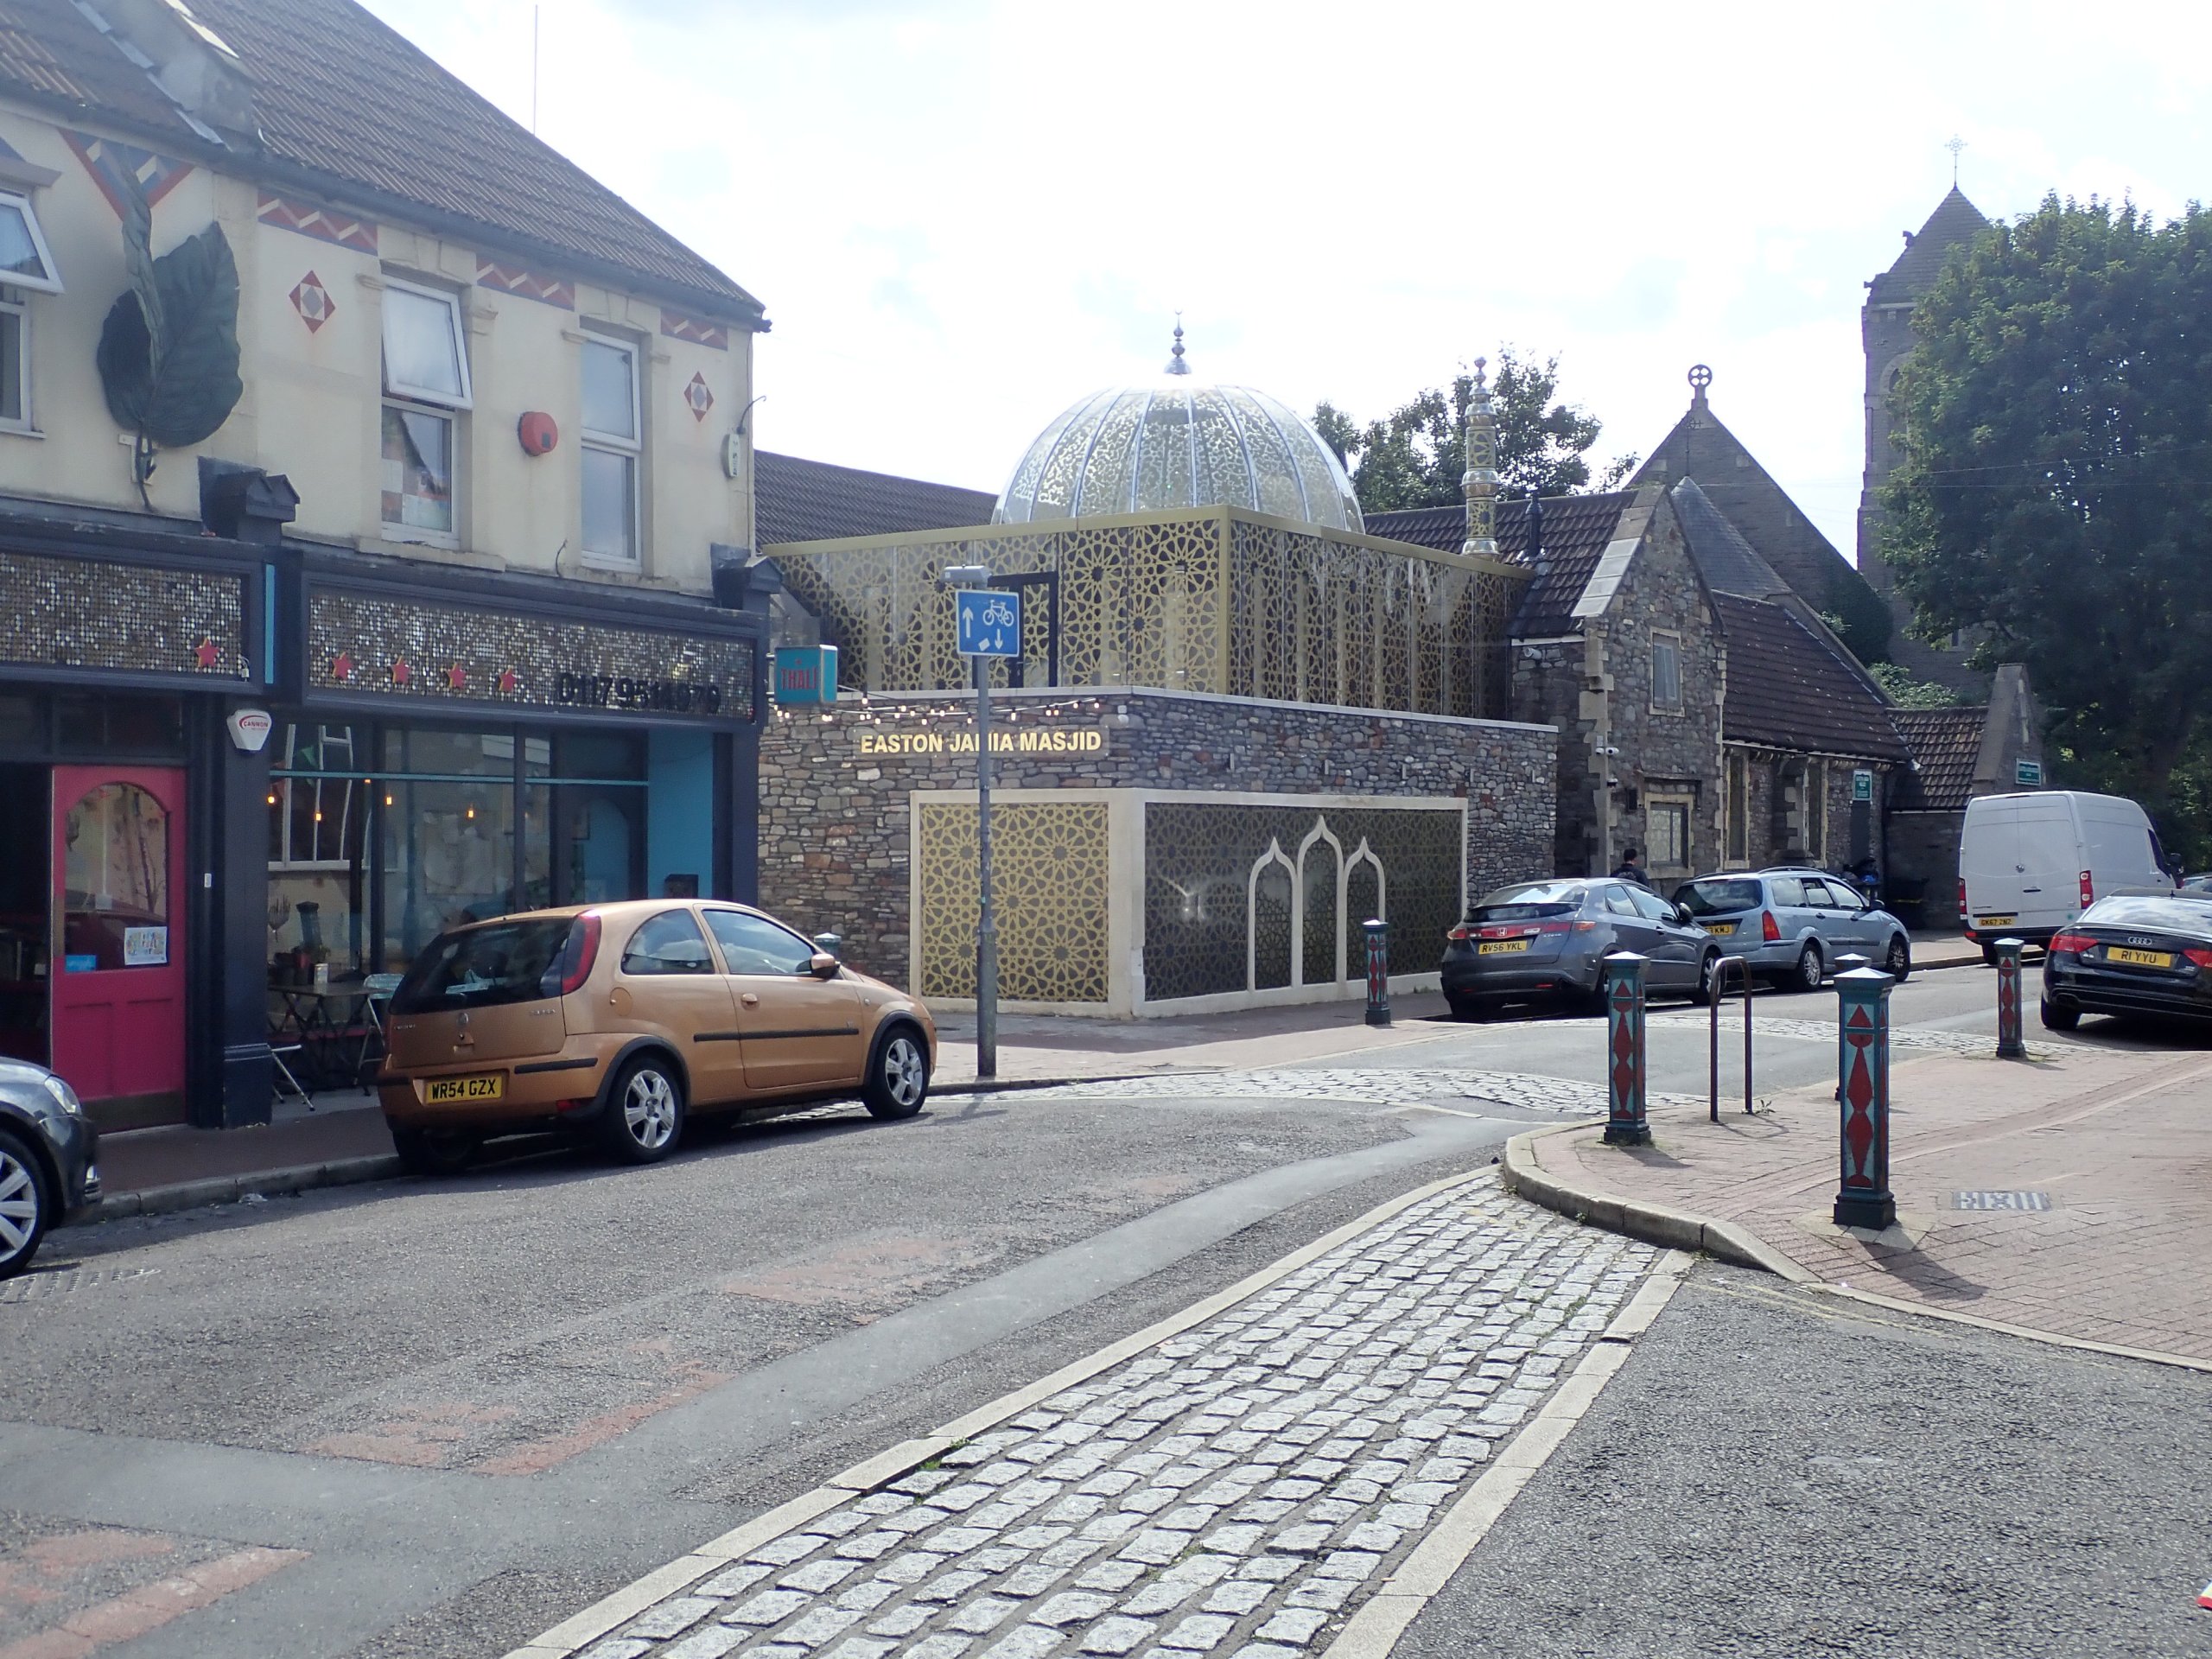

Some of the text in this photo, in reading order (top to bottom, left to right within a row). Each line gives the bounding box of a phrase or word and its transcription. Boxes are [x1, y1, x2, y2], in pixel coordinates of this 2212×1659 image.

[861, 734, 943, 753] EASTON
[1020, 731, 1102, 752] MASJID
[1482, 941, 1522, 953] RV56 YKL
[2135, 951, 2157, 964] YYU
[432, 1078, 496, 1100] WR54 GZX
